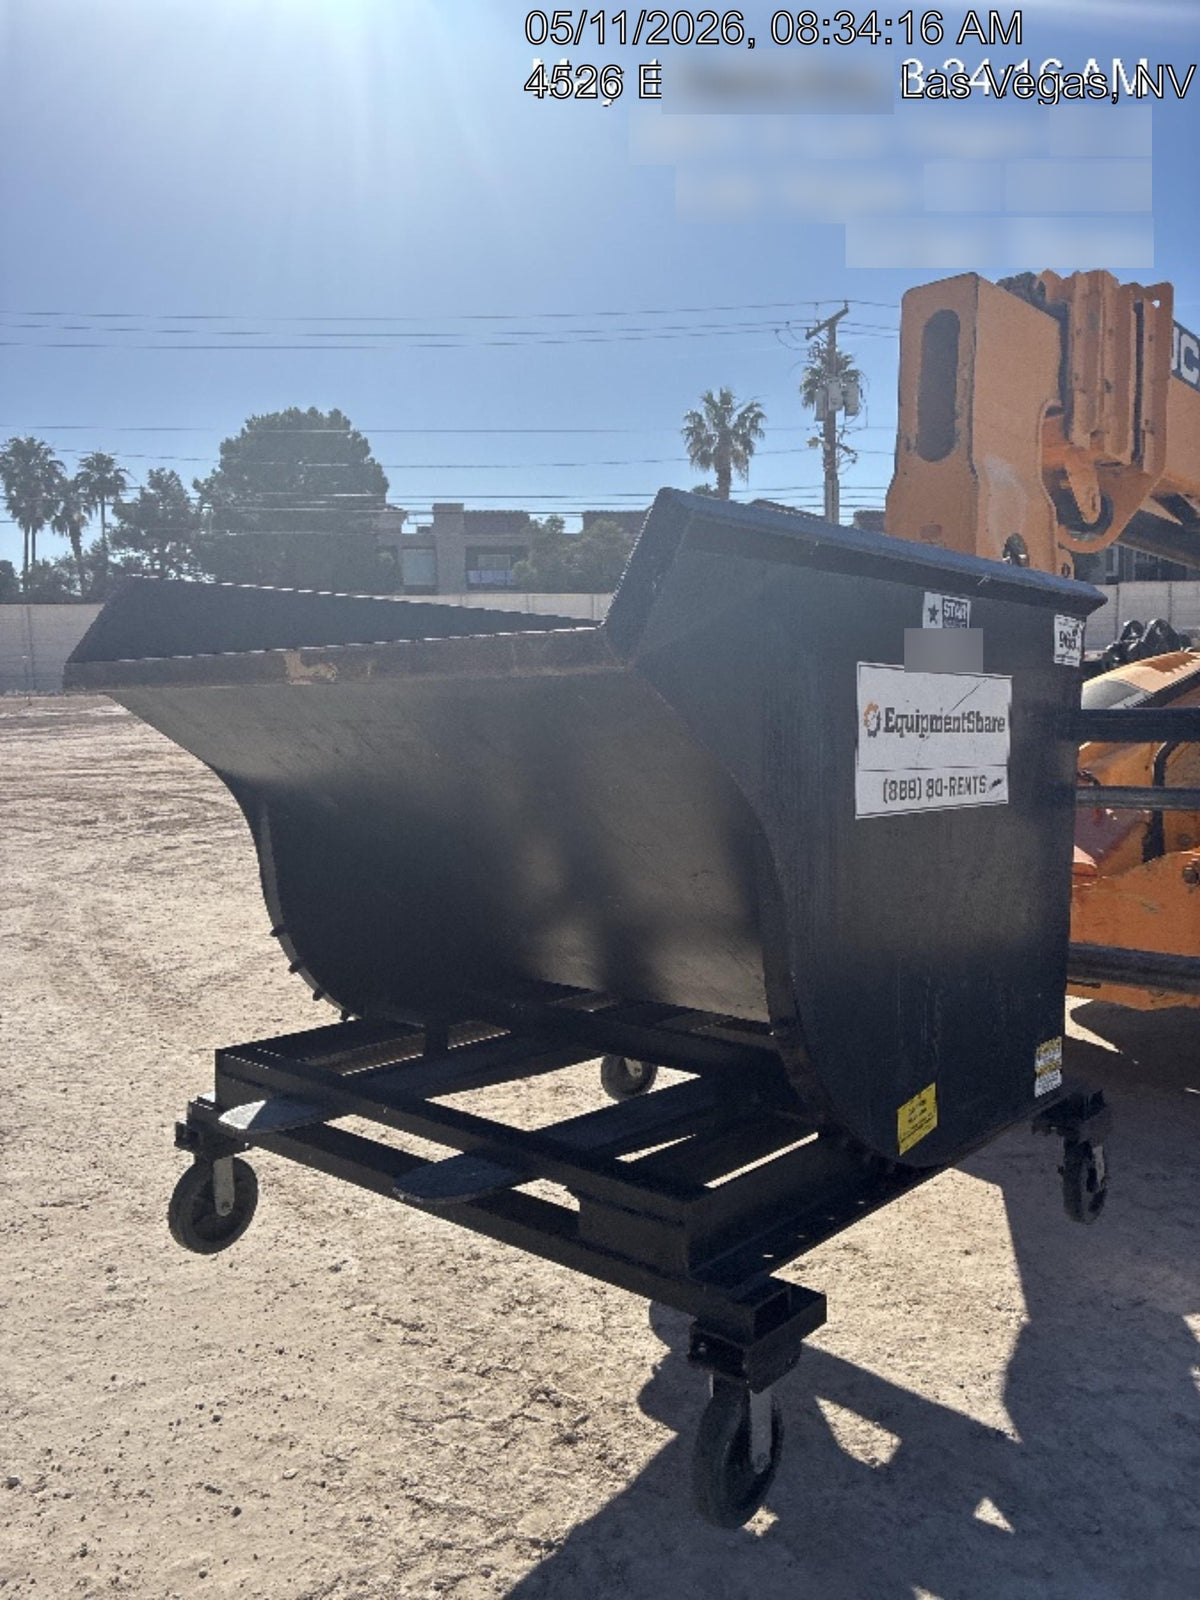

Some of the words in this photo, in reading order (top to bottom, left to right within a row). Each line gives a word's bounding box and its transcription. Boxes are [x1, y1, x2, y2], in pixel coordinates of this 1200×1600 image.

[883, 707, 1006, 738] EquipmentShare
[882, 777, 922, 804] (888)
[926, 774, 988, 800] 80-RENTS
